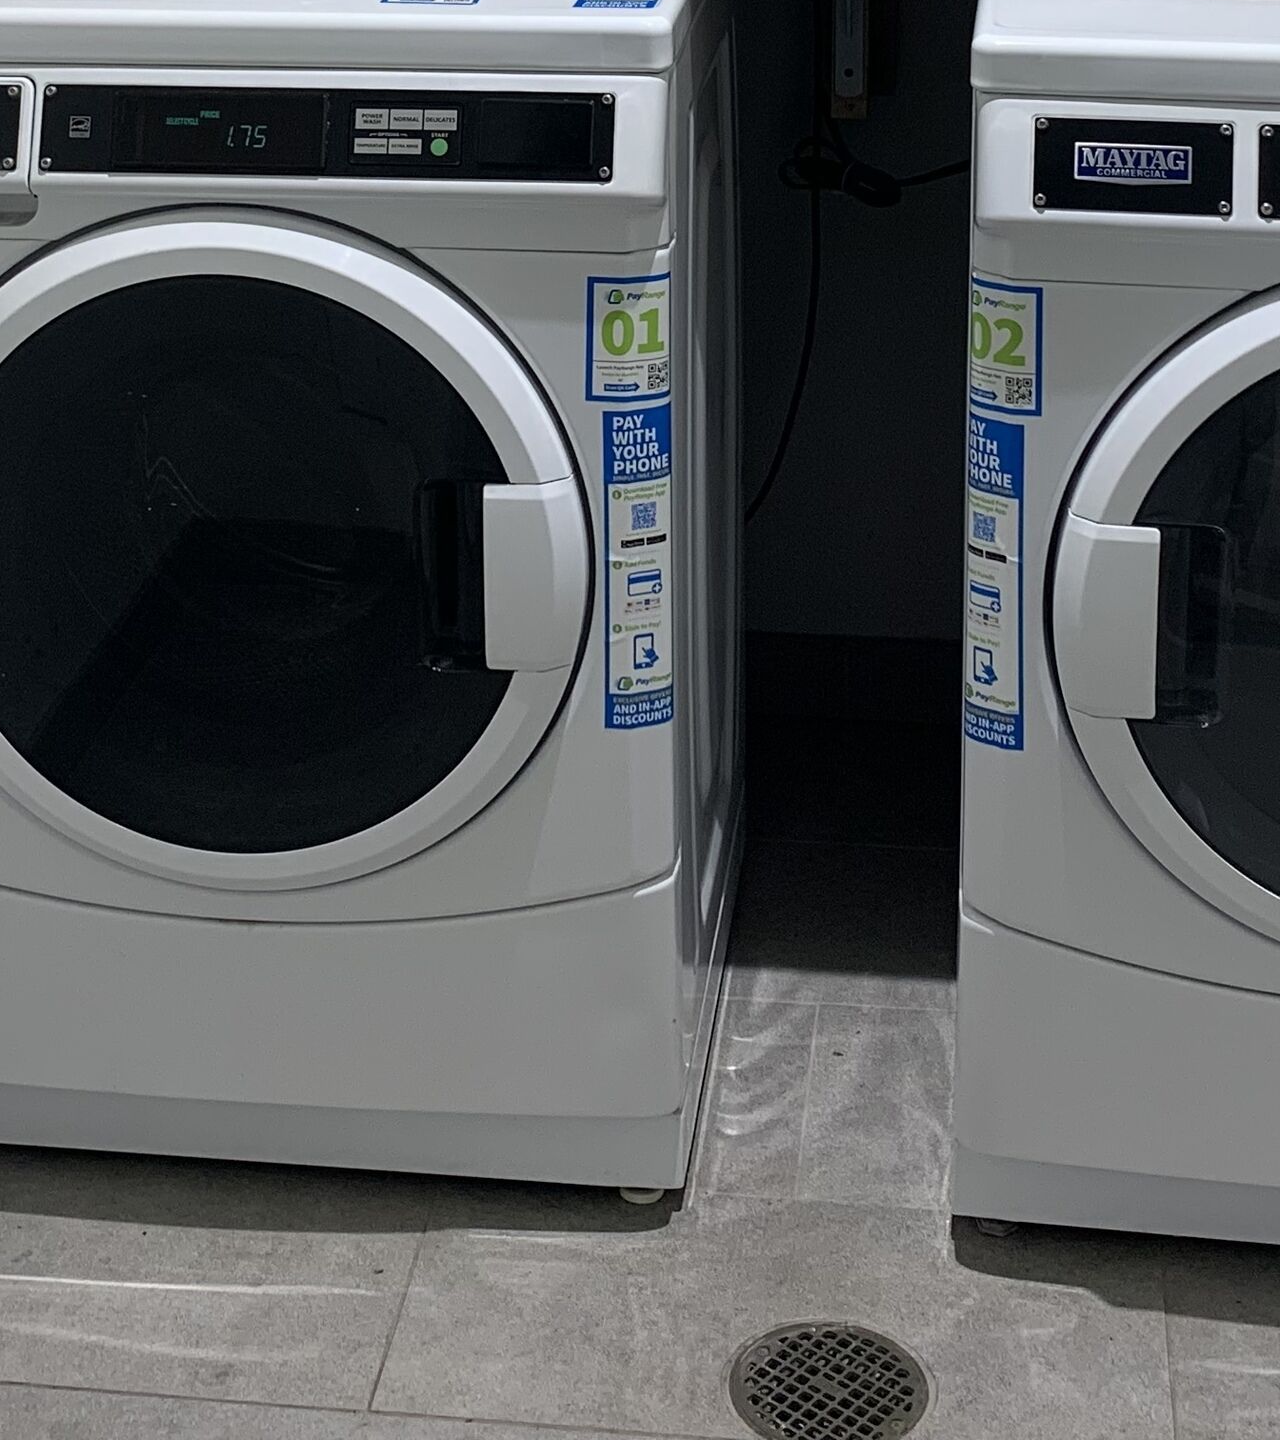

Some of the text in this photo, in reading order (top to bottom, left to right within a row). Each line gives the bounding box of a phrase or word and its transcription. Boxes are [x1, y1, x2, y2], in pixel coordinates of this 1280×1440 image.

[227, 125, 268, 148] 1.75
[1081, 147, 1186, 171] MAYTAG
[1096, 168, 1168, 179] COMMERCIAL
[627, 290, 665, 301] PayRange
[984, 296, 1026, 311] PayRange
[601, 308, 665, 356] 01
[971, 311, 1025, 366] 02
[612, 414, 644, 430] PAY
[970, 419, 986, 436] AY
[612, 427, 656, 445] WITH
[970, 433, 998, 455] ITH
[612, 442, 659, 460] YOUR
[970, 449, 1000, 471] OUR
[613, 453, 669, 475] PHONE
[970, 464, 1012, 489] HONE
[613, 695, 672, 715] AND IN-APP
[975, 691, 1016, 708] PayRange
[613, 706, 672, 726] DISCOUNTS
[978, 717, 1015, 735] IN-APP
